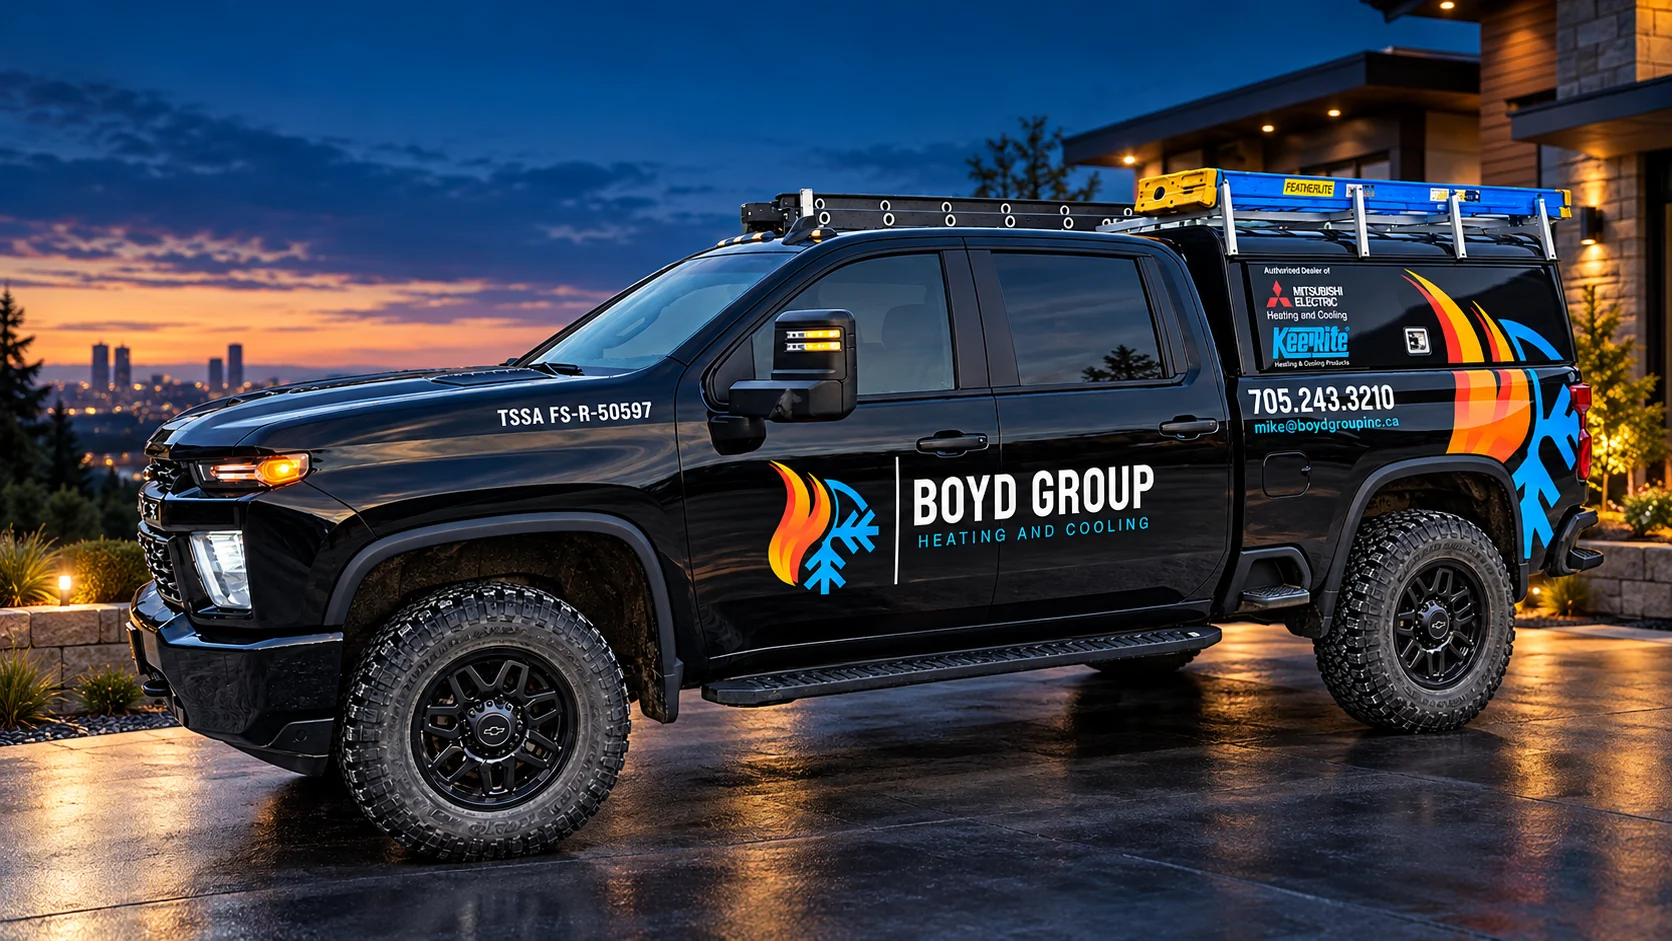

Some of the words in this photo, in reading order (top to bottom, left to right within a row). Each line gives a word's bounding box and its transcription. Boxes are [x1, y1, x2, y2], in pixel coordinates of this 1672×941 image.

[1285, 182, 1333, 194] FEATHERLITE
[1301, 266, 1322, 275] Dealer
[1292, 286, 1344, 296] MITSUBISHI
[1294, 297, 1338, 307] ELECTRIC
[1266, 310, 1299, 322] Heating
[1301, 311, 1316, 320] and
[1317, 310, 1348, 321] Cooling
[1247, 384, 1395, 415] 705.243.3210
[497, 407, 545, 427] TSSA
[549, 401, 652, 424] FS-R-50597
[1254, 416, 1400, 434] mike@boydgroupinc.ca
[913, 473, 1017, 527] BOYD
[1032, 464, 1154, 518] GROUP
[918, 528, 1007, 549] HEATING
[1016, 524, 1055, 541] AND
[1065, 516, 1150, 537] COOLING
